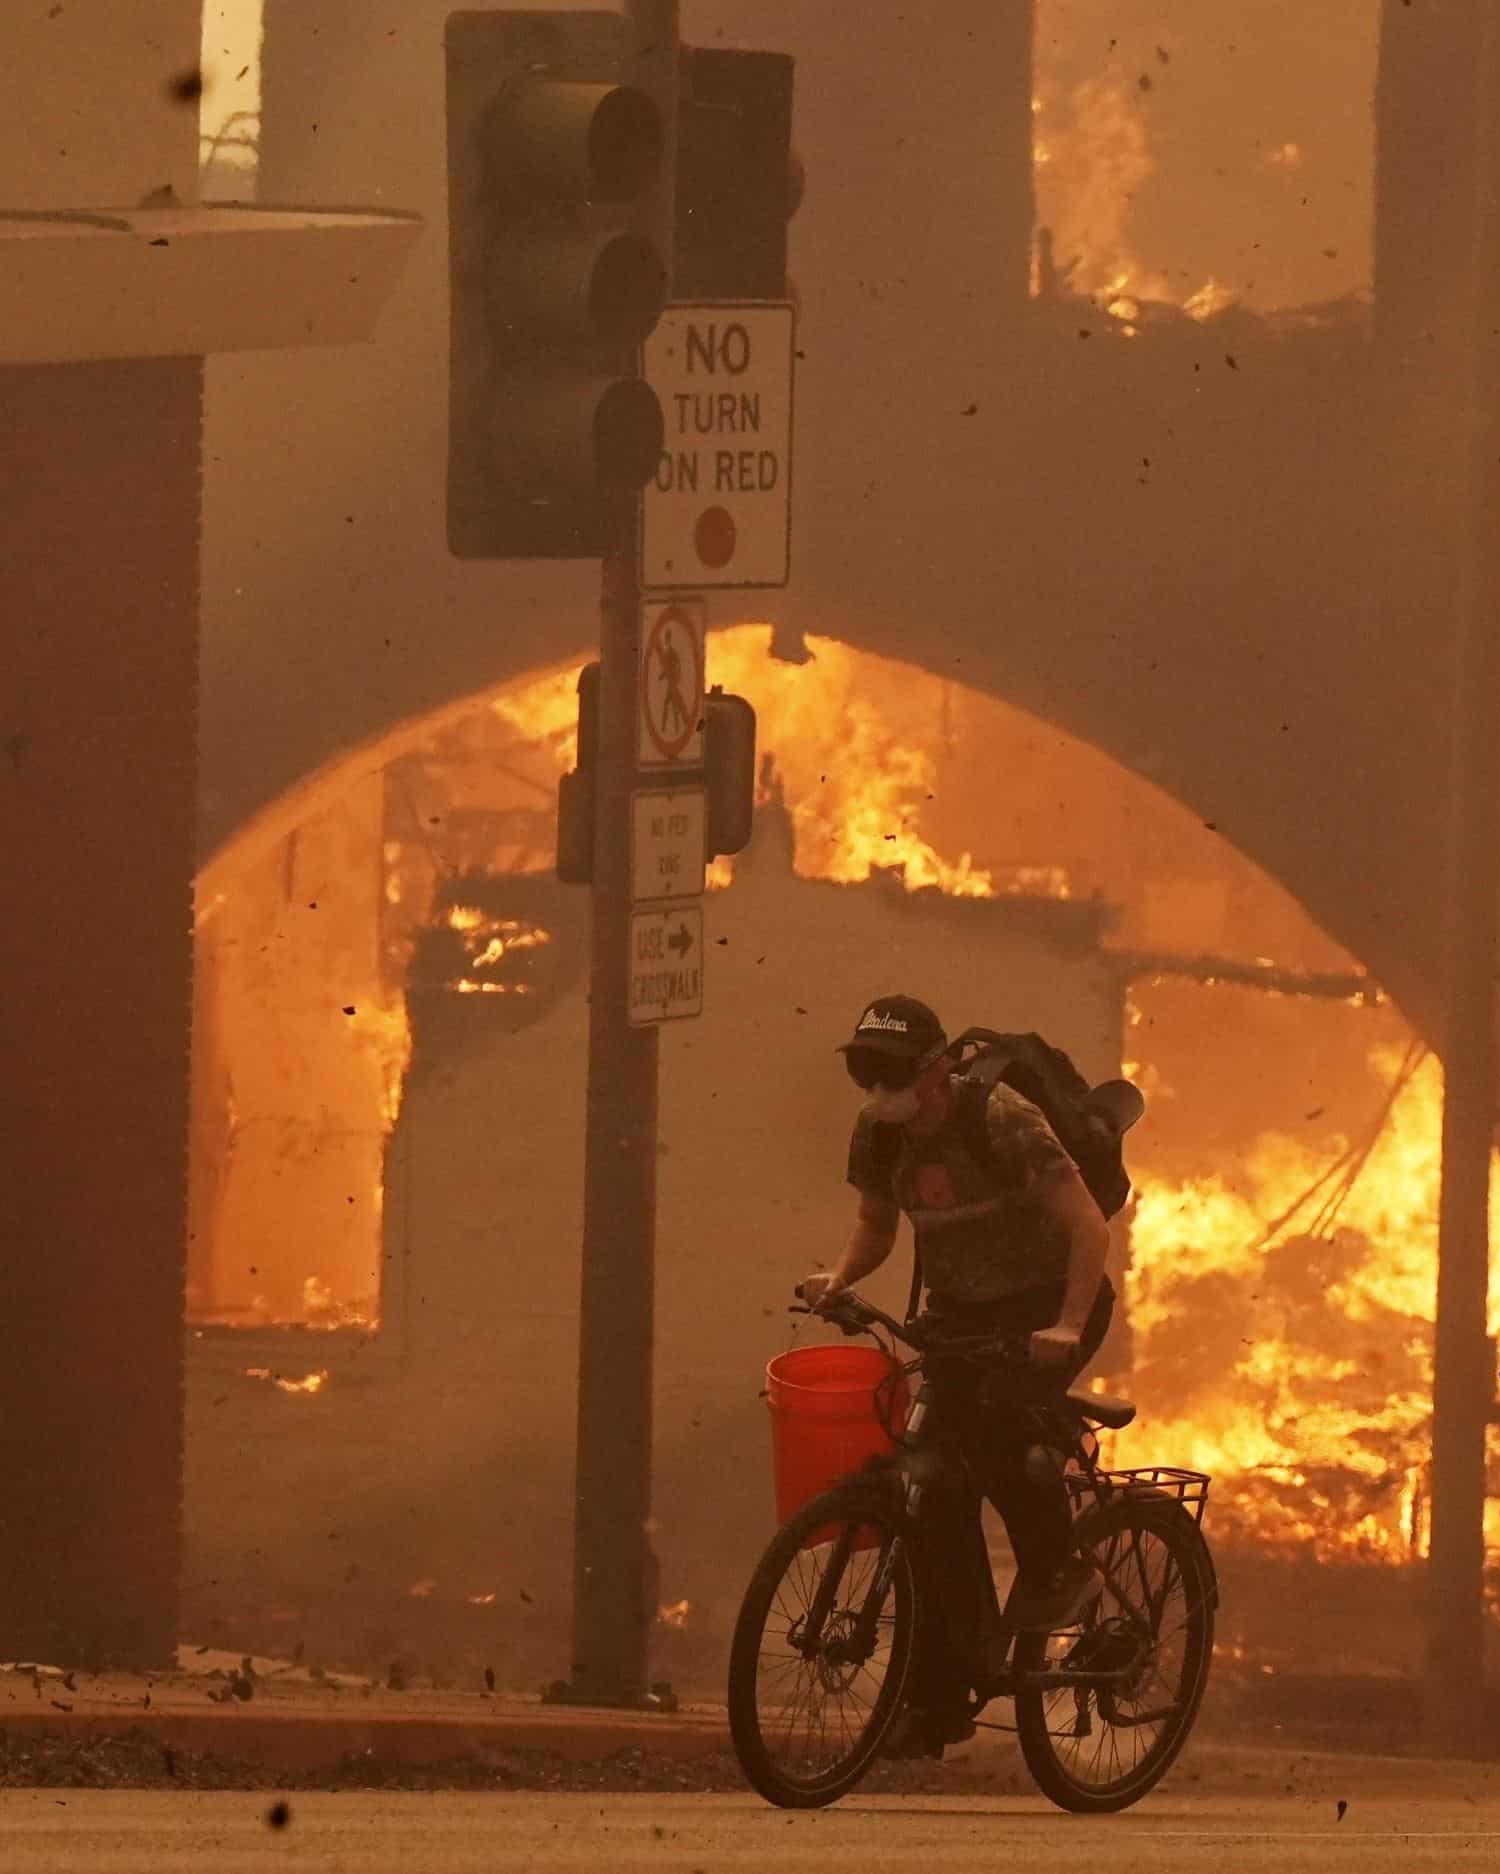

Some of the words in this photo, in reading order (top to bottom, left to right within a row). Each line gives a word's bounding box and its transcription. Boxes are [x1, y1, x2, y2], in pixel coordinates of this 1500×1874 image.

[686, 322, 750, 374] NO
[673, 393, 760, 433] TURN
[655, 452, 698, 491] ON
[715, 450, 778, 491] RED
[638, 927, 665, 960] USE
[633, 968, 700, 1007] CROSSWALK
